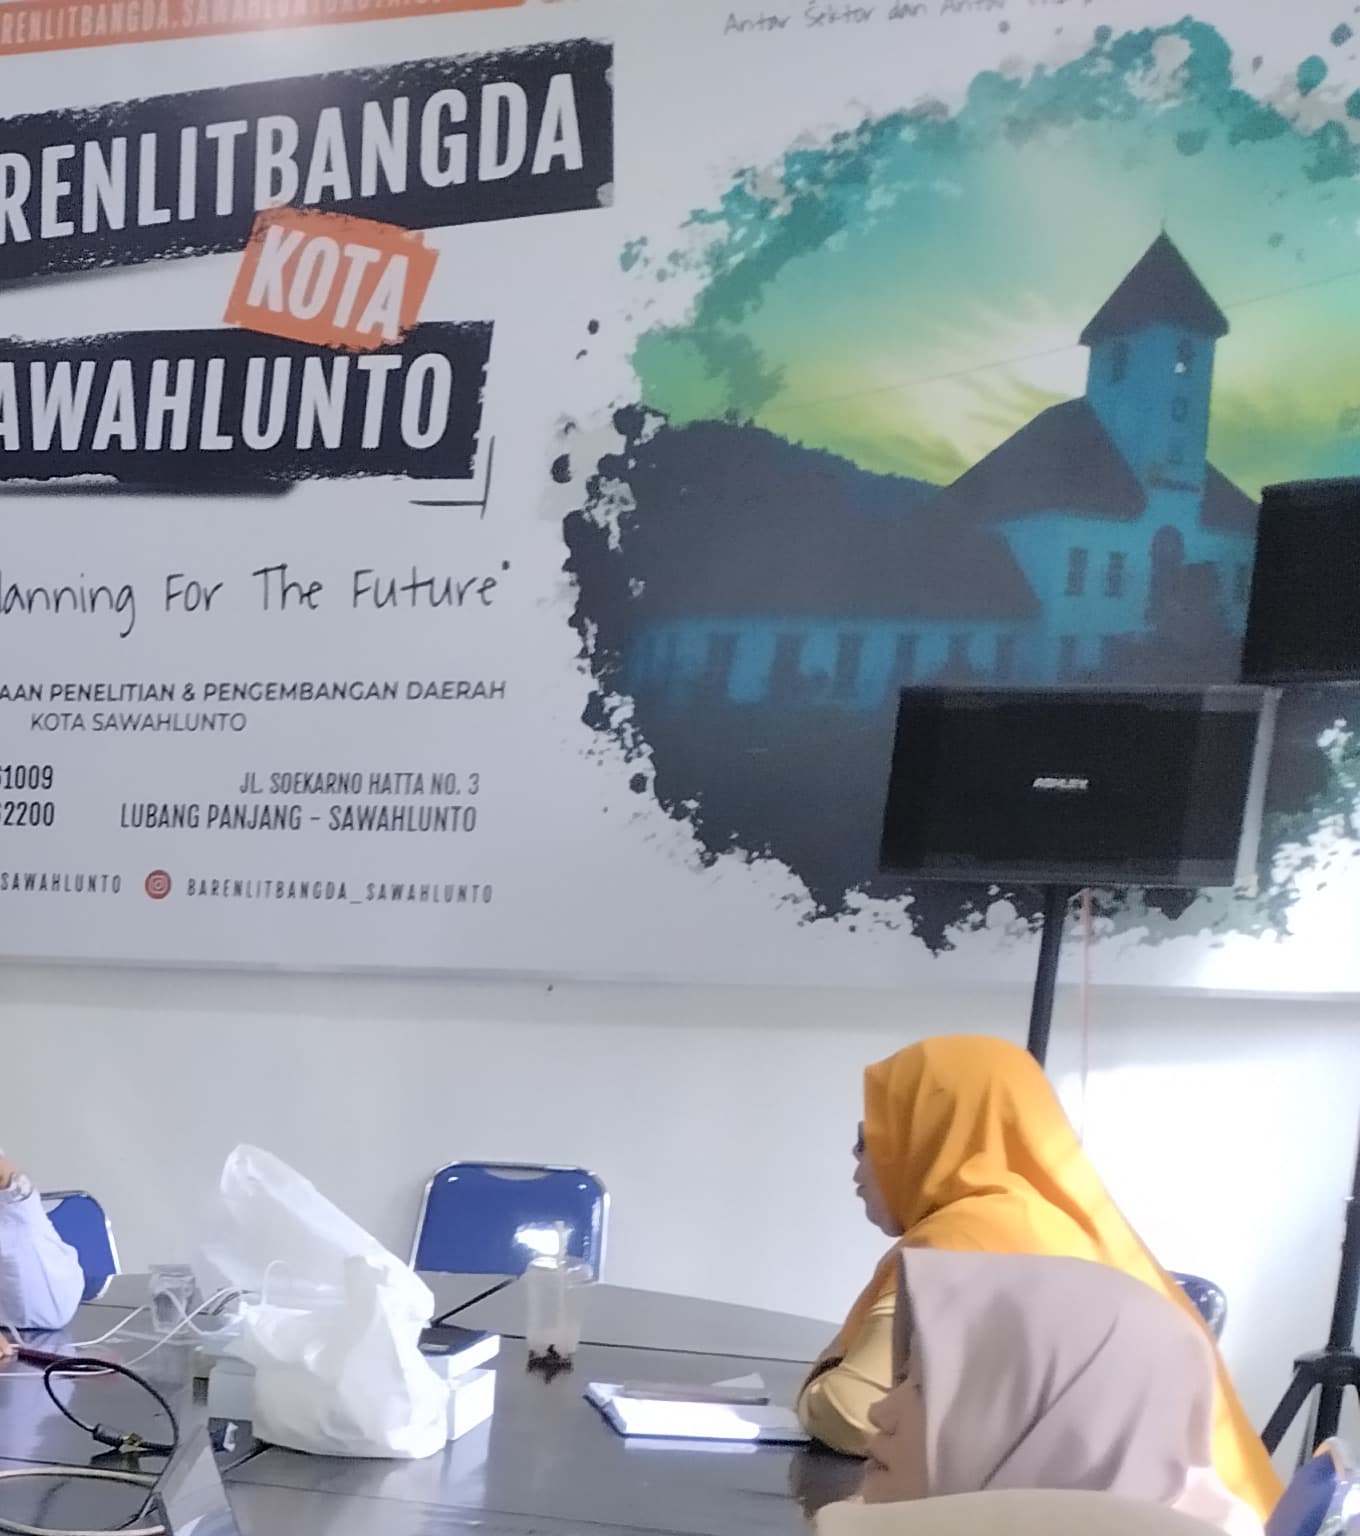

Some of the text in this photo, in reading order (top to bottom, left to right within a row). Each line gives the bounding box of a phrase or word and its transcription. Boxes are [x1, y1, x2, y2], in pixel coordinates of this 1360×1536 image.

[244, 225, 411, 338] KOTA
[165, 573, 223, 612] For
[252, 563, 323, 610] The
[50, 683, 175, 702] PENELITIAN
[182, 682, 196, 702] &
[204, 681, 399, 701] PENGEMBANGAN
[406, 680, 506, 700] DAERAH
[30, 712, 247, 732] KOTA SAWAHLUNTO
[269, 772, 362, 795] SOEKARNO
[369, 772, 424, 795] HATTA
[430, 772, 461, 795] NO.
[468, 773, 480, 795] 3
[120, 803, 200, 829] LUBANG
[207, 804, 301, 830] PANJANG
[328, 805, 476, 832] SAWAHLUNTO
[186, 878, 492, 904] BARENLITBANGDA_SAWAHLUNTO
